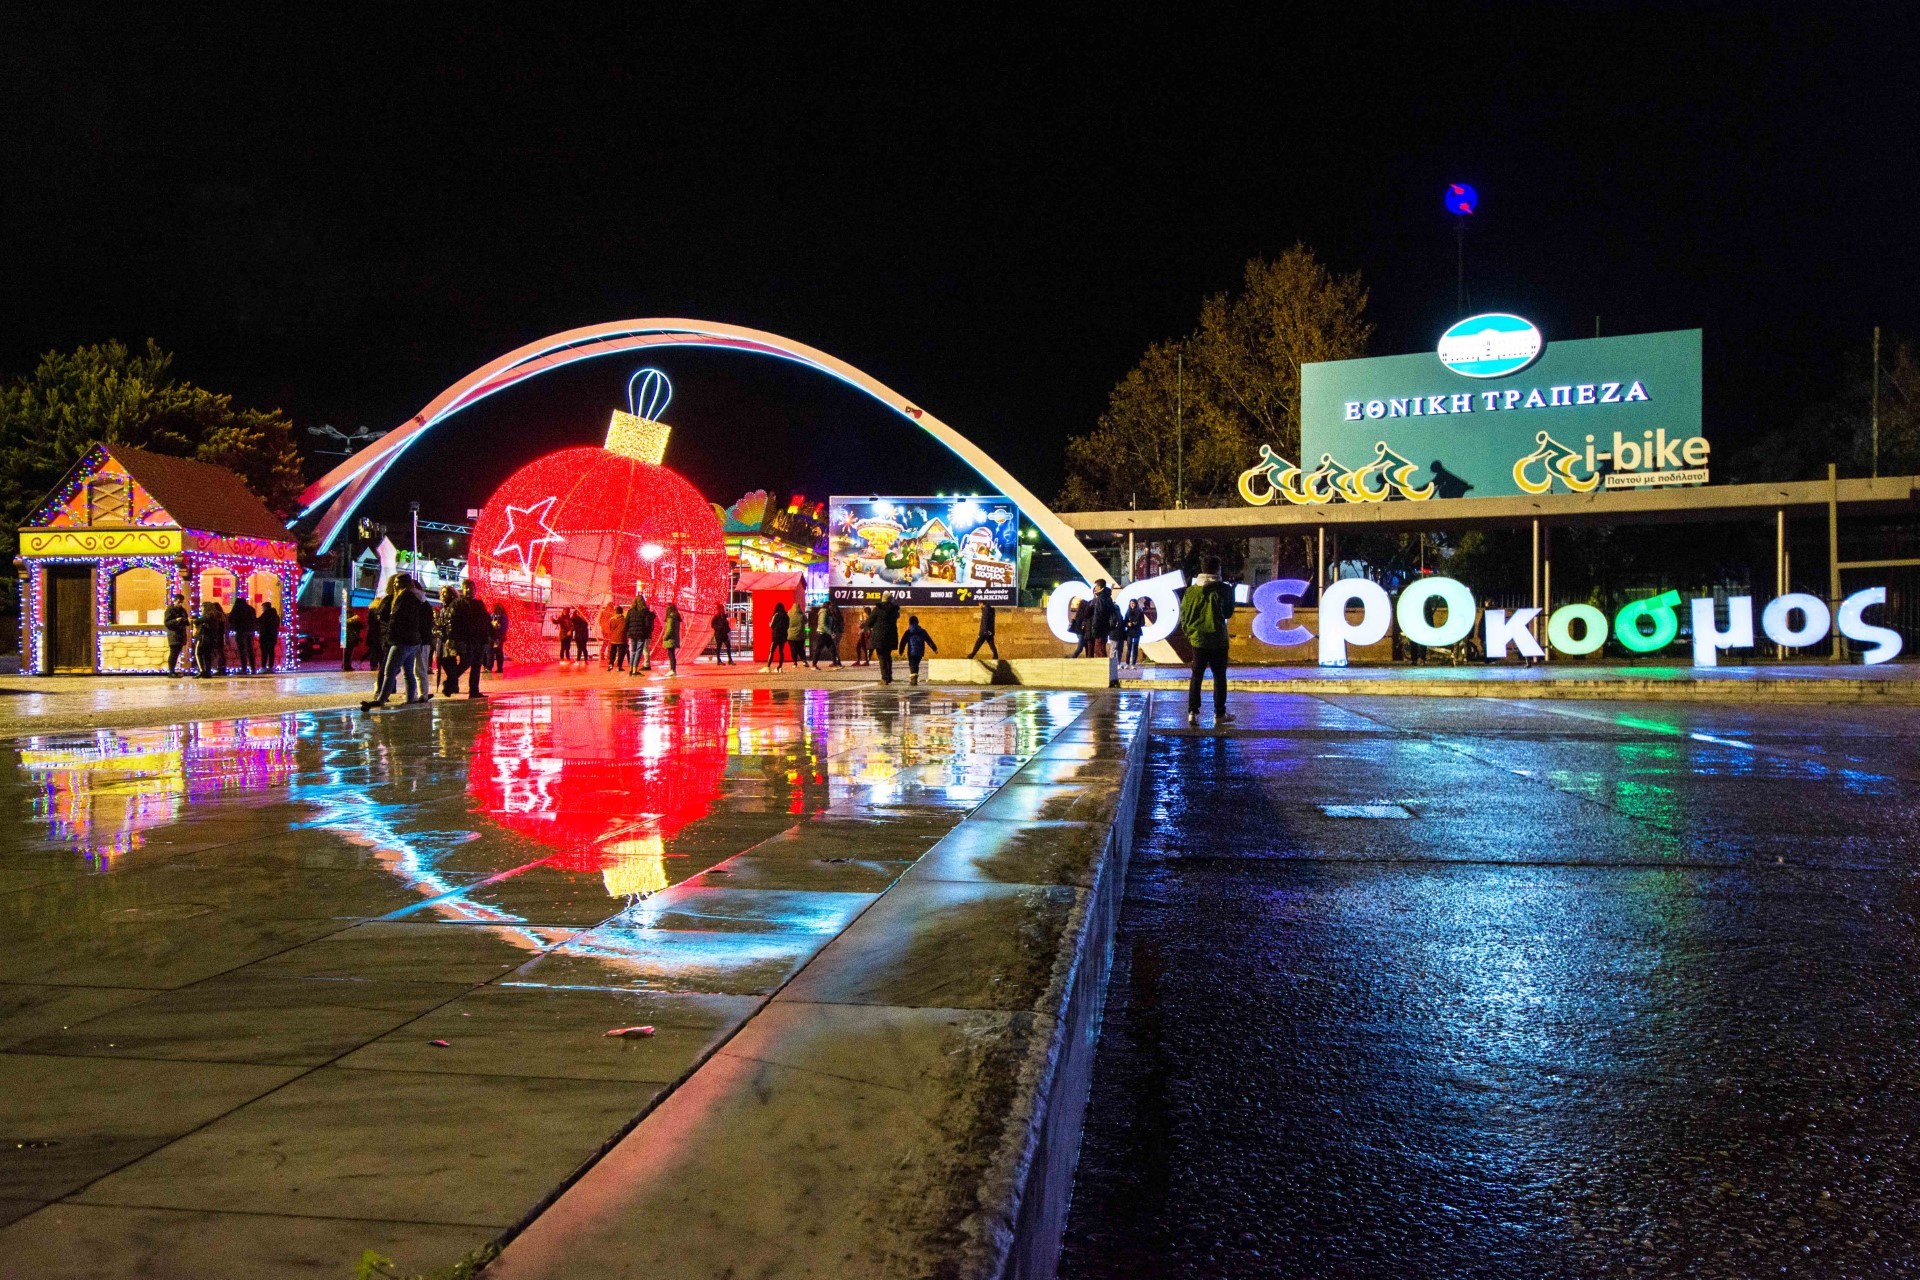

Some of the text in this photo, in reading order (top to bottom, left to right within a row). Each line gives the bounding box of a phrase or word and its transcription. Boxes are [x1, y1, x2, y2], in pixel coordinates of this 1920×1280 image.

[1344, 380, 1650, 421] ΕΘΝΙΚΗ ΤΡΑΠΕΖΑ
[1585, 428, 1711, 472] i-bike
[1607, 472, 1707, 486] Παντού με ποδήλατο!
[834, 590, 864, 600] 07/12
